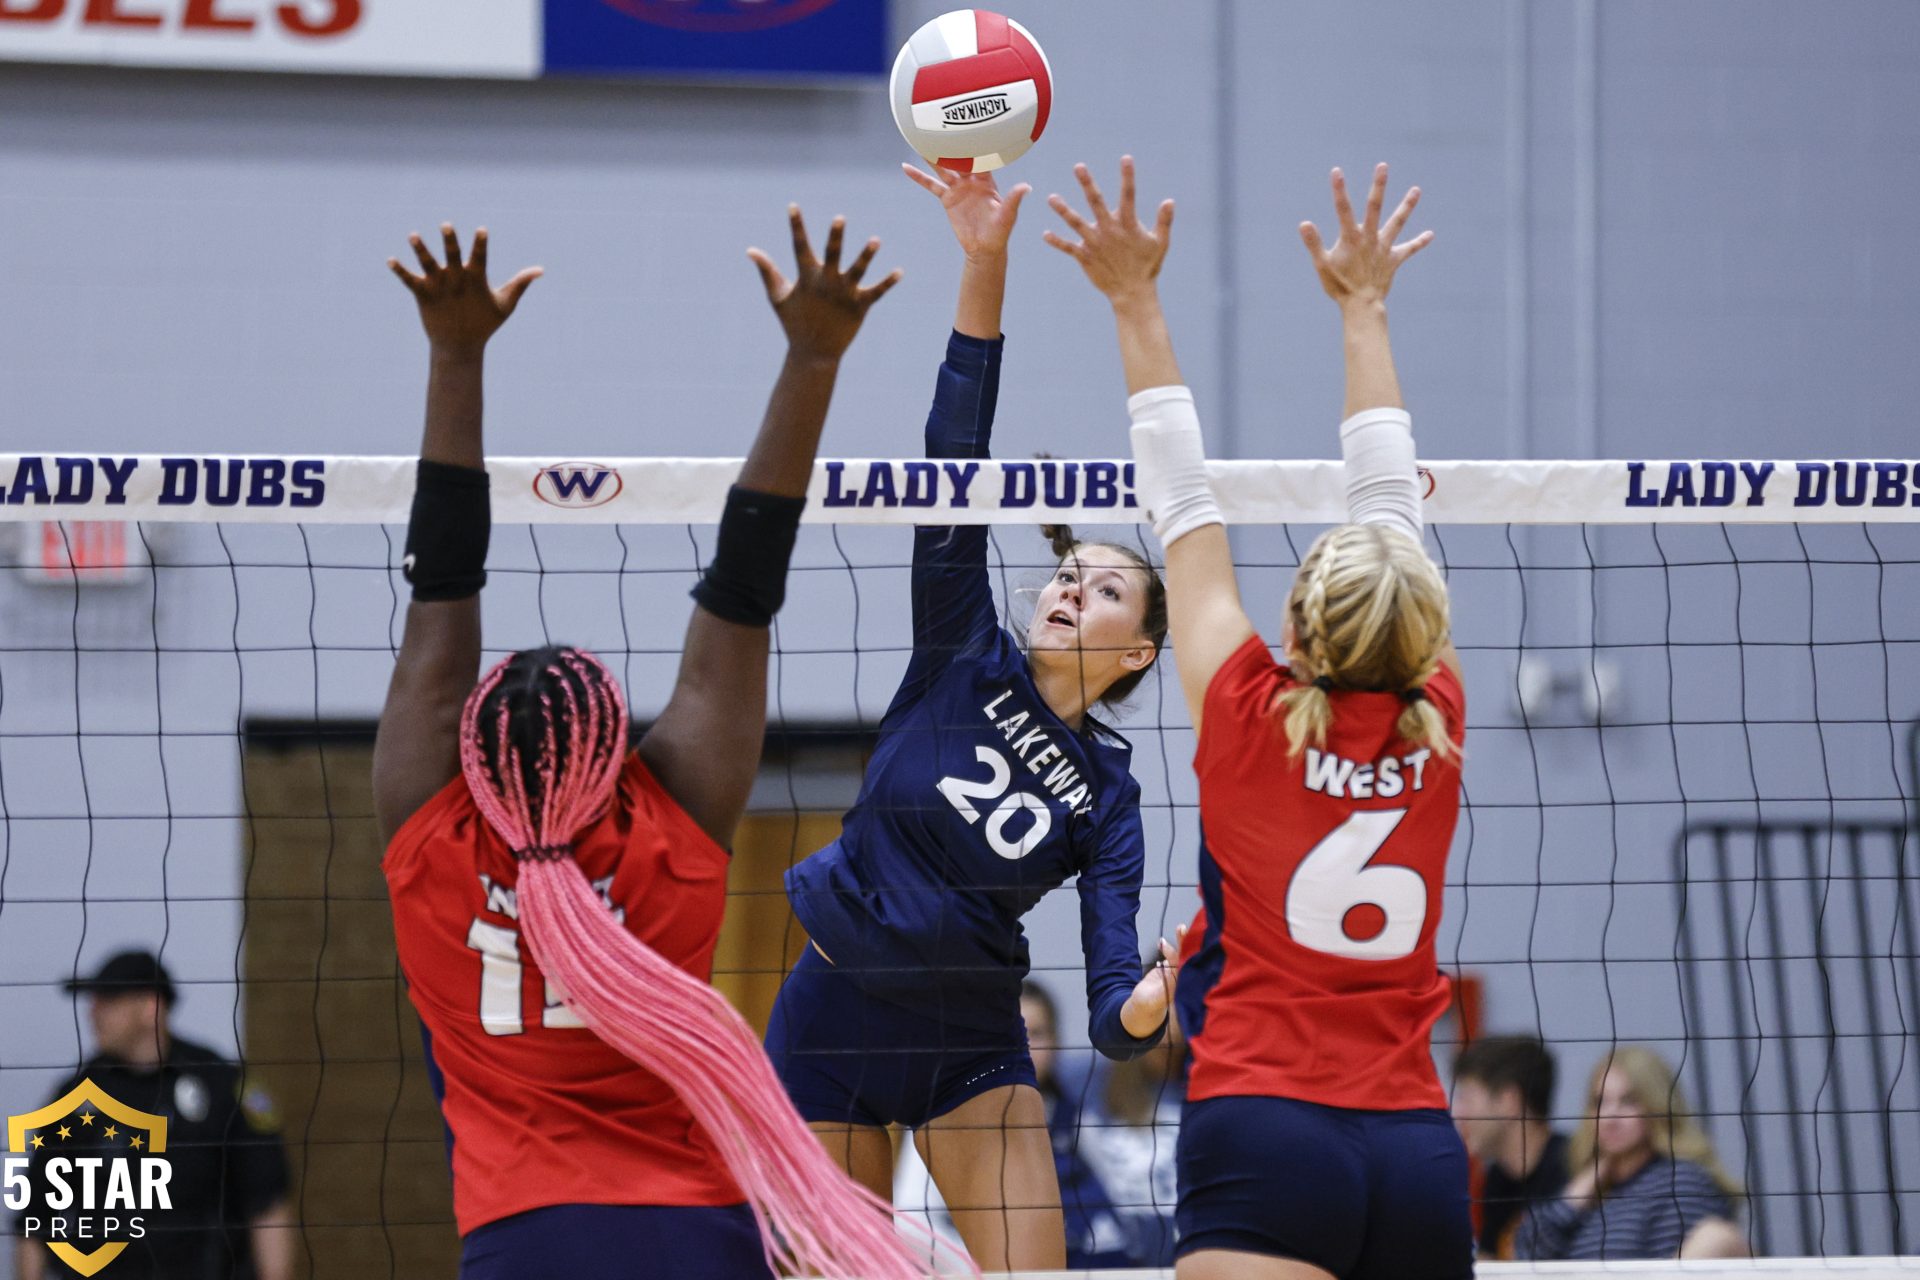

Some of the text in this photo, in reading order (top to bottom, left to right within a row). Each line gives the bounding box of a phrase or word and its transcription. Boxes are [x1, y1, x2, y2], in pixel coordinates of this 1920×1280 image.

[943, 98, 1011, 121] TACHIKARA
[0, 457, 325, 507] ADY DUBS
[540, 467, 617, 502] W
[823, 461, 980, 508] LADY
[1625, 462, 1920, 507] LADY DUB
[983, 689, 1093, 818] LAKEWAY
[1304, 747, 1431, 799] WEST
[936, 745, 1052, 860] 20
[1285, 807, 1427, 961] 6
